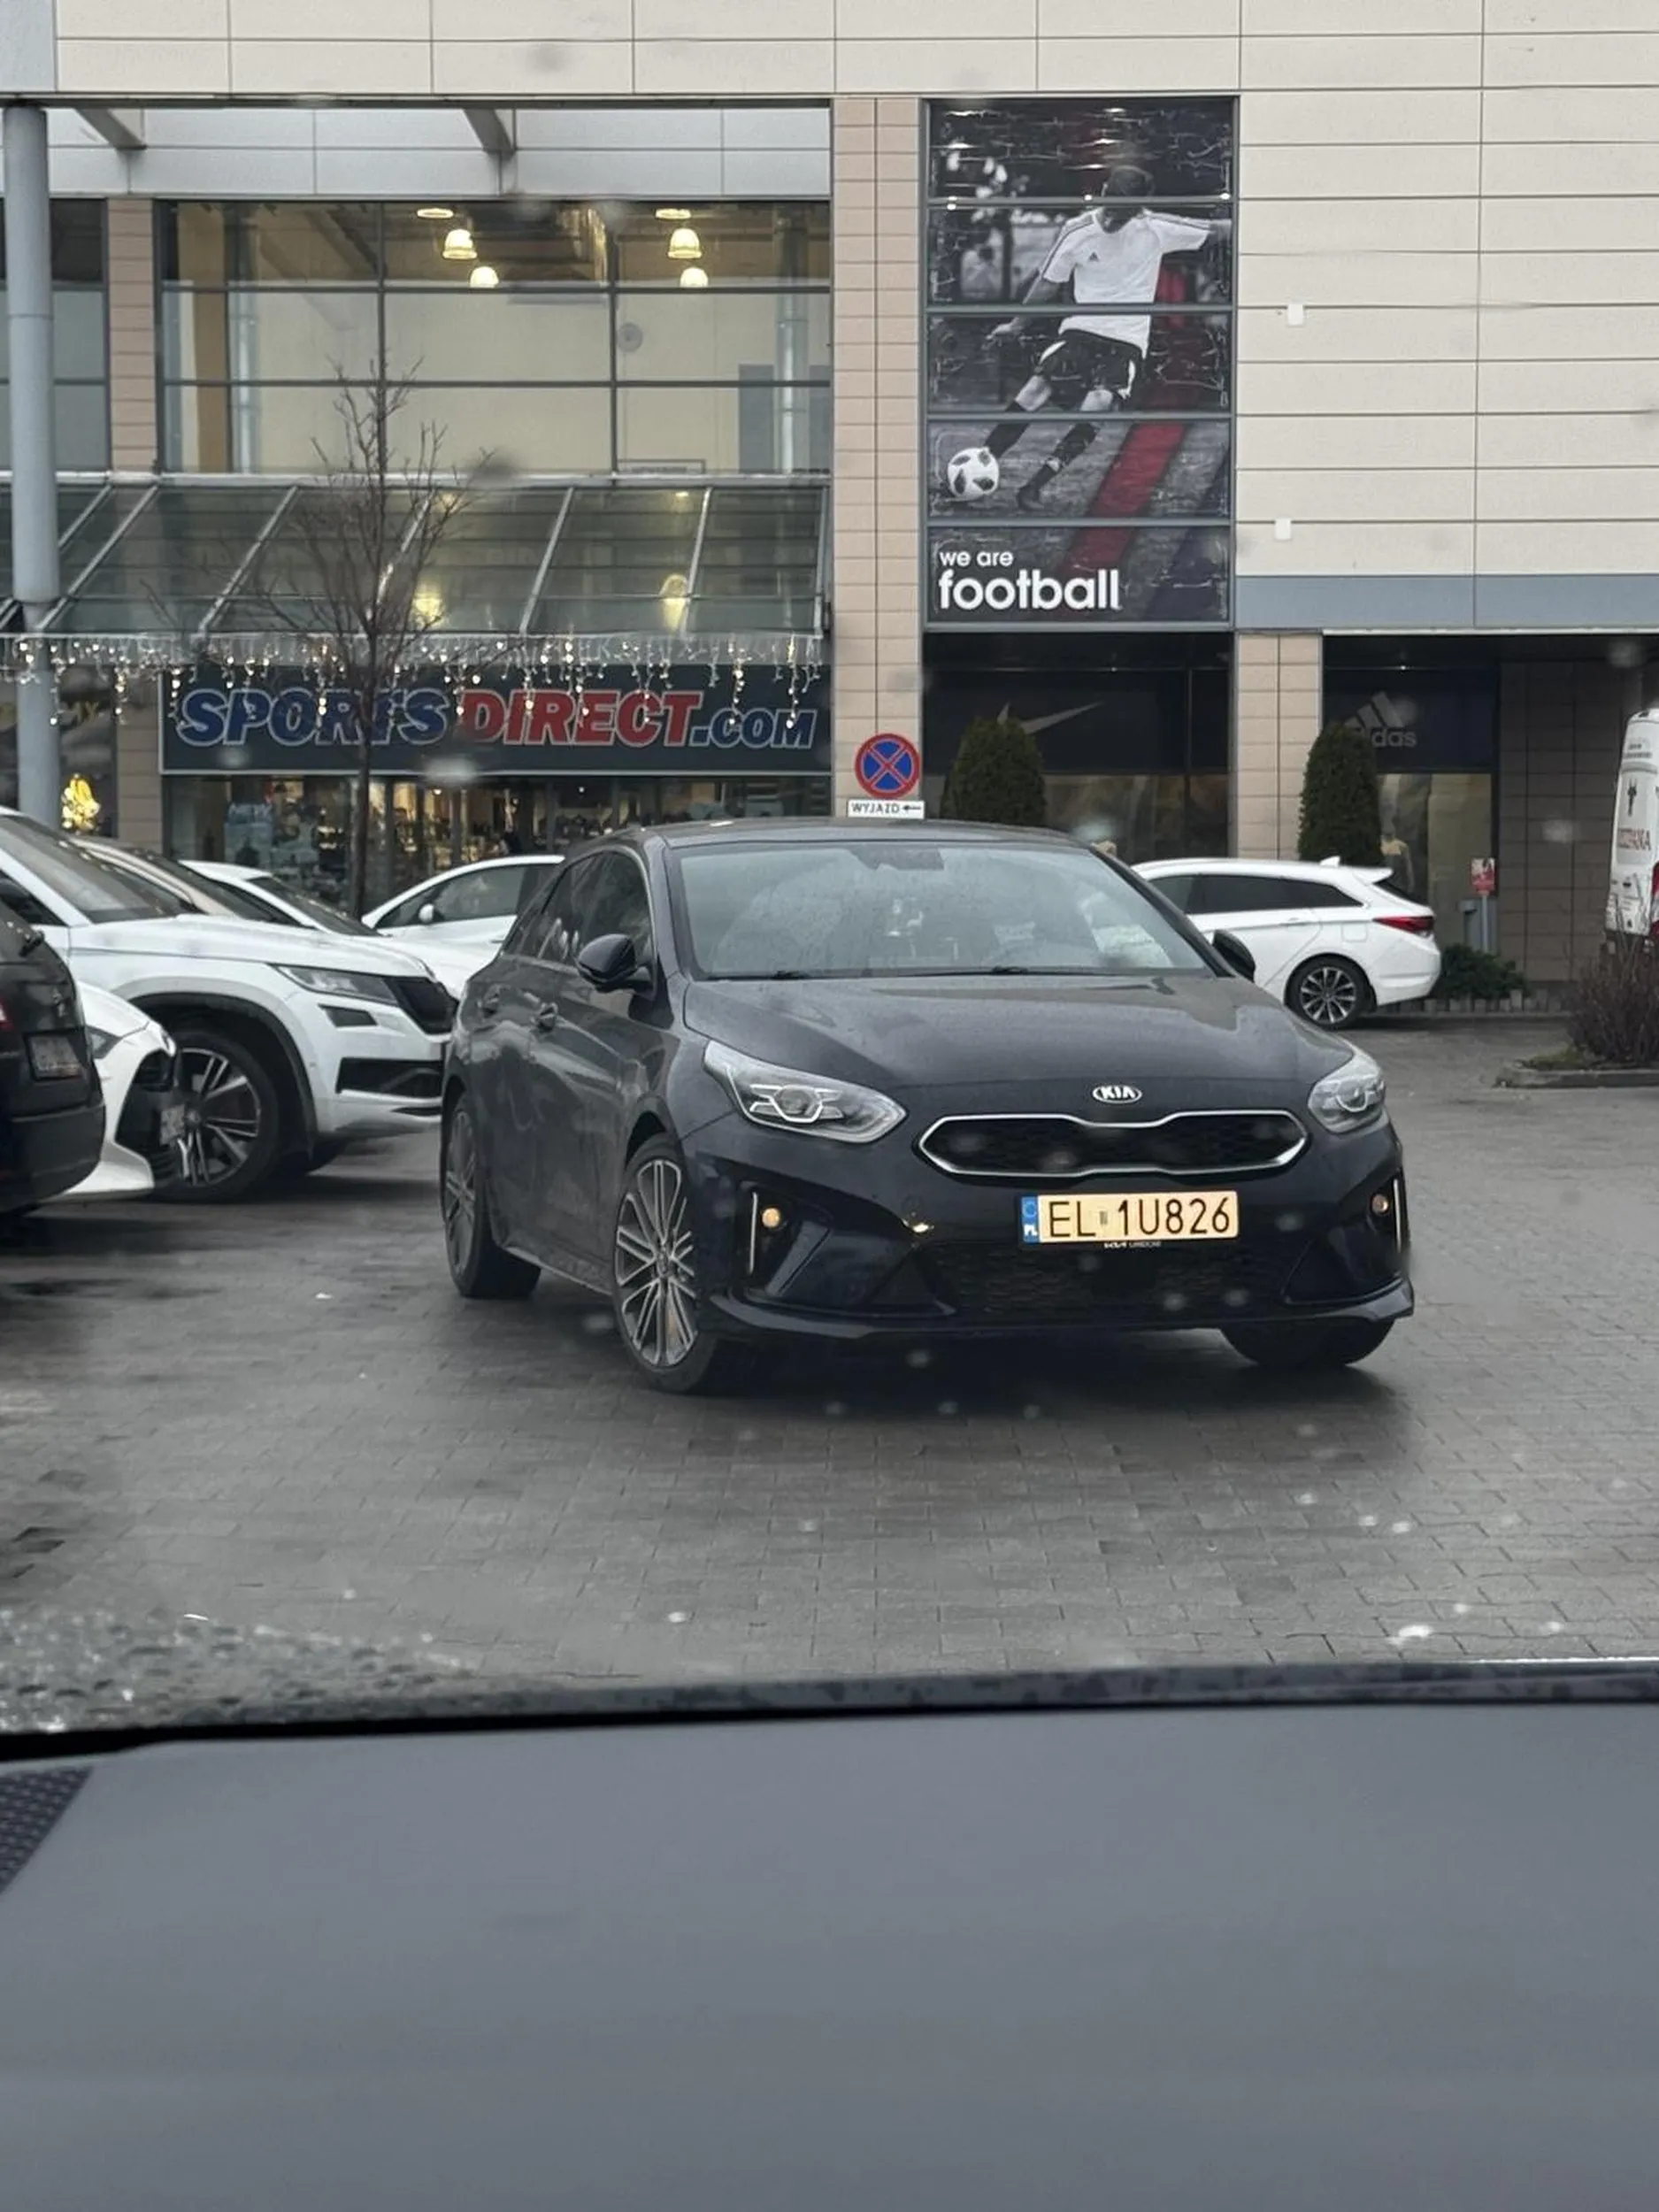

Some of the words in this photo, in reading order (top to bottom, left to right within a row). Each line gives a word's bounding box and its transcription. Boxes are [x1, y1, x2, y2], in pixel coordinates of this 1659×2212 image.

[939, 551, 972, 567] we
[976, 551, 1014, 567] are
[939, 568, 1120, 610] football
[177, 687, 449, 746] SPORTS
[851, 803, 900, 814] WYJAZD
[1101, 1085, 1137, 1100] KIA
[1049, 1200, 1097, 1238] EL
[1118, 1196, 1231, 1236] 1U826
